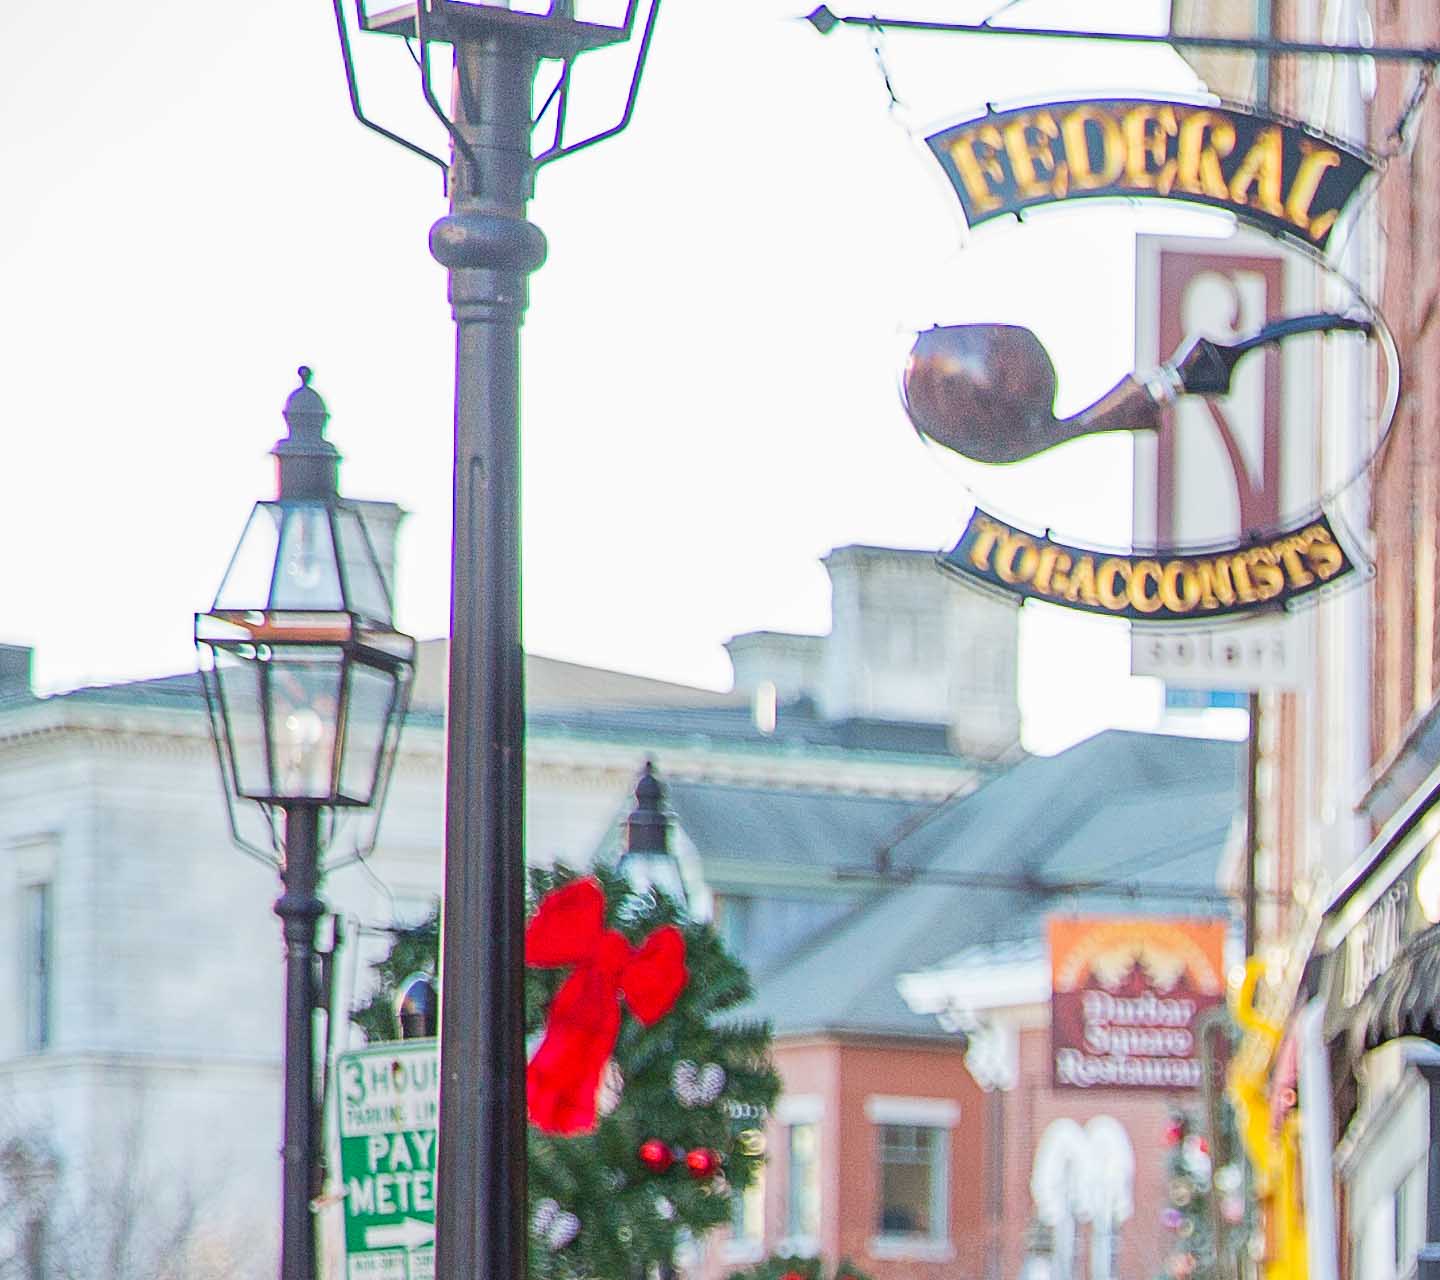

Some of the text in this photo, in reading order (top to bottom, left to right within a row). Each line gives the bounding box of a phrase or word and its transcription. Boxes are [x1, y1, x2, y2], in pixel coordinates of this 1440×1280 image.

[946, 105, 1342, 242] FEDERAL
[968, 516, 1344, 613] TOBACCONISTS
[1082, 1024, 1195, 1058] Square
[345, 1061, 366, 1105] 3
[1055, 1048, 1203, 1088] Restauran
[367, 1131, 435, 1173] PAY
[350, 1171, 434, 1217] METE
